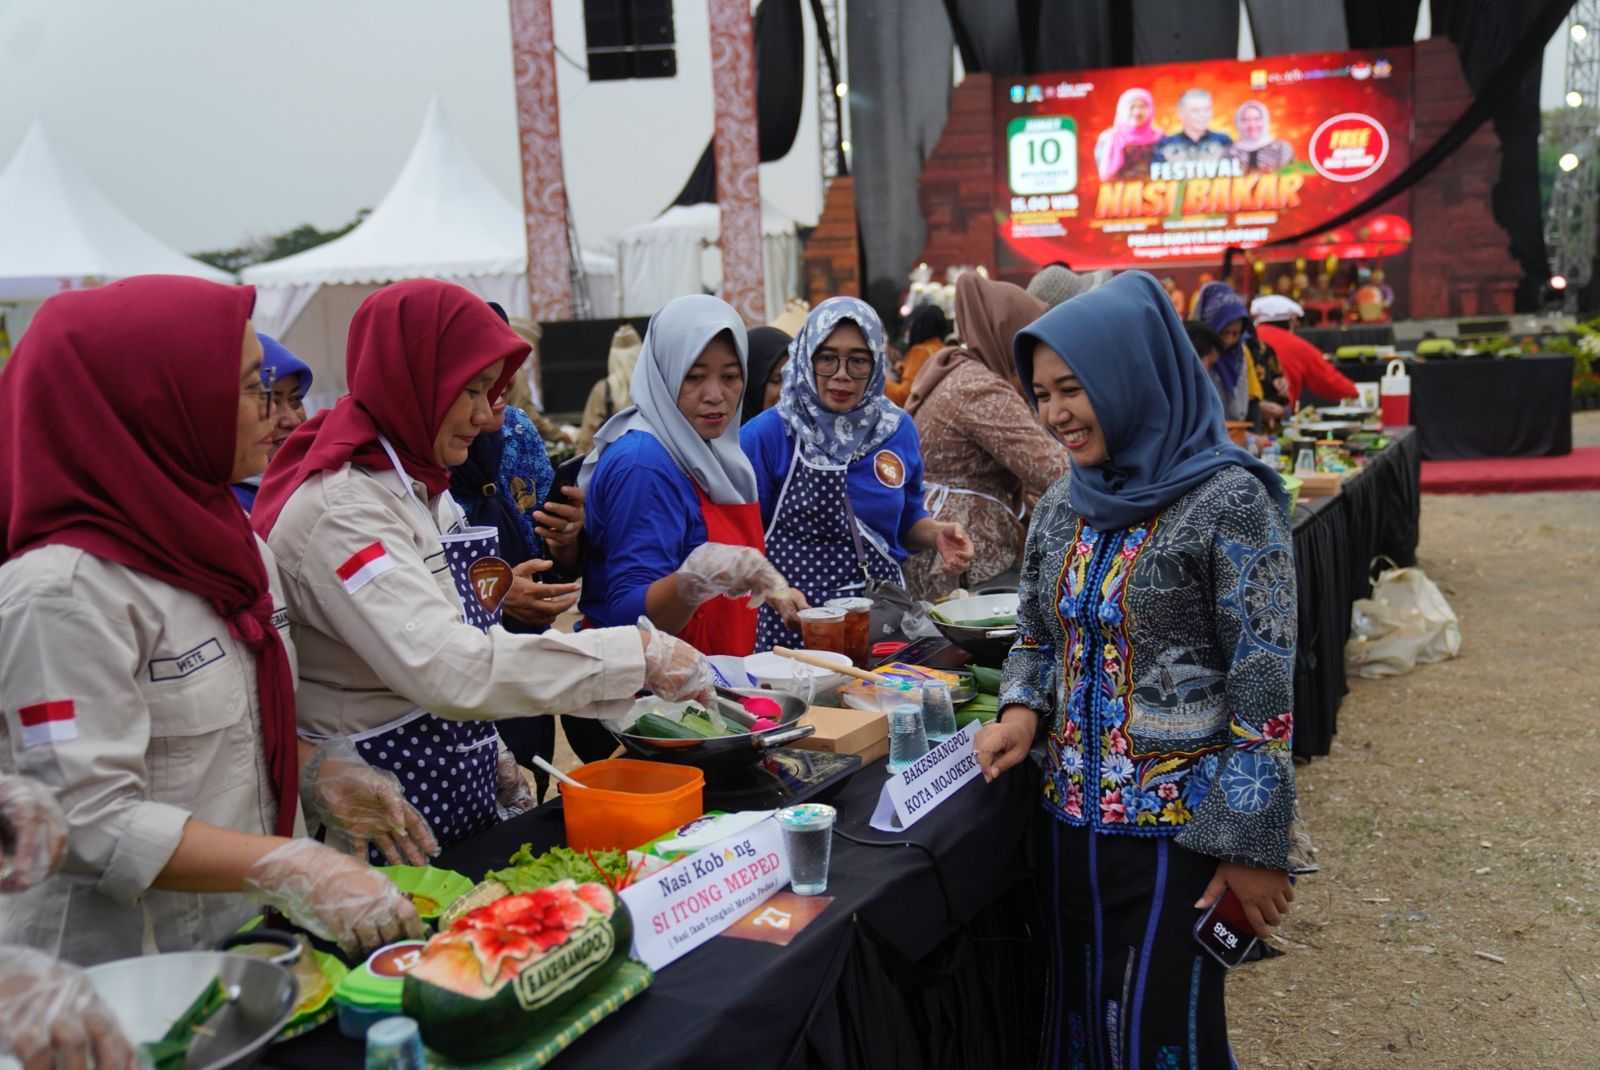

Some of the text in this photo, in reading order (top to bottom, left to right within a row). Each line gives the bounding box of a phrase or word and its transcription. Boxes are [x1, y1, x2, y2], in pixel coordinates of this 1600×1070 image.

[1027, 138, 1061, 165] 10
[1150, 158, 1244, 180] FESTIVAL
[1094, 173, 1304, 218] NASI BAKAR
[477, 576, 499, 600] 27
[902, 730, 970, 785] BAKESBANGPOL
[904, 751, 978, 814] KOTA MOJOKER
[651, 852, 781, 935] SI ITONG MEPED
[658, 866, 692, 897] Nasi
